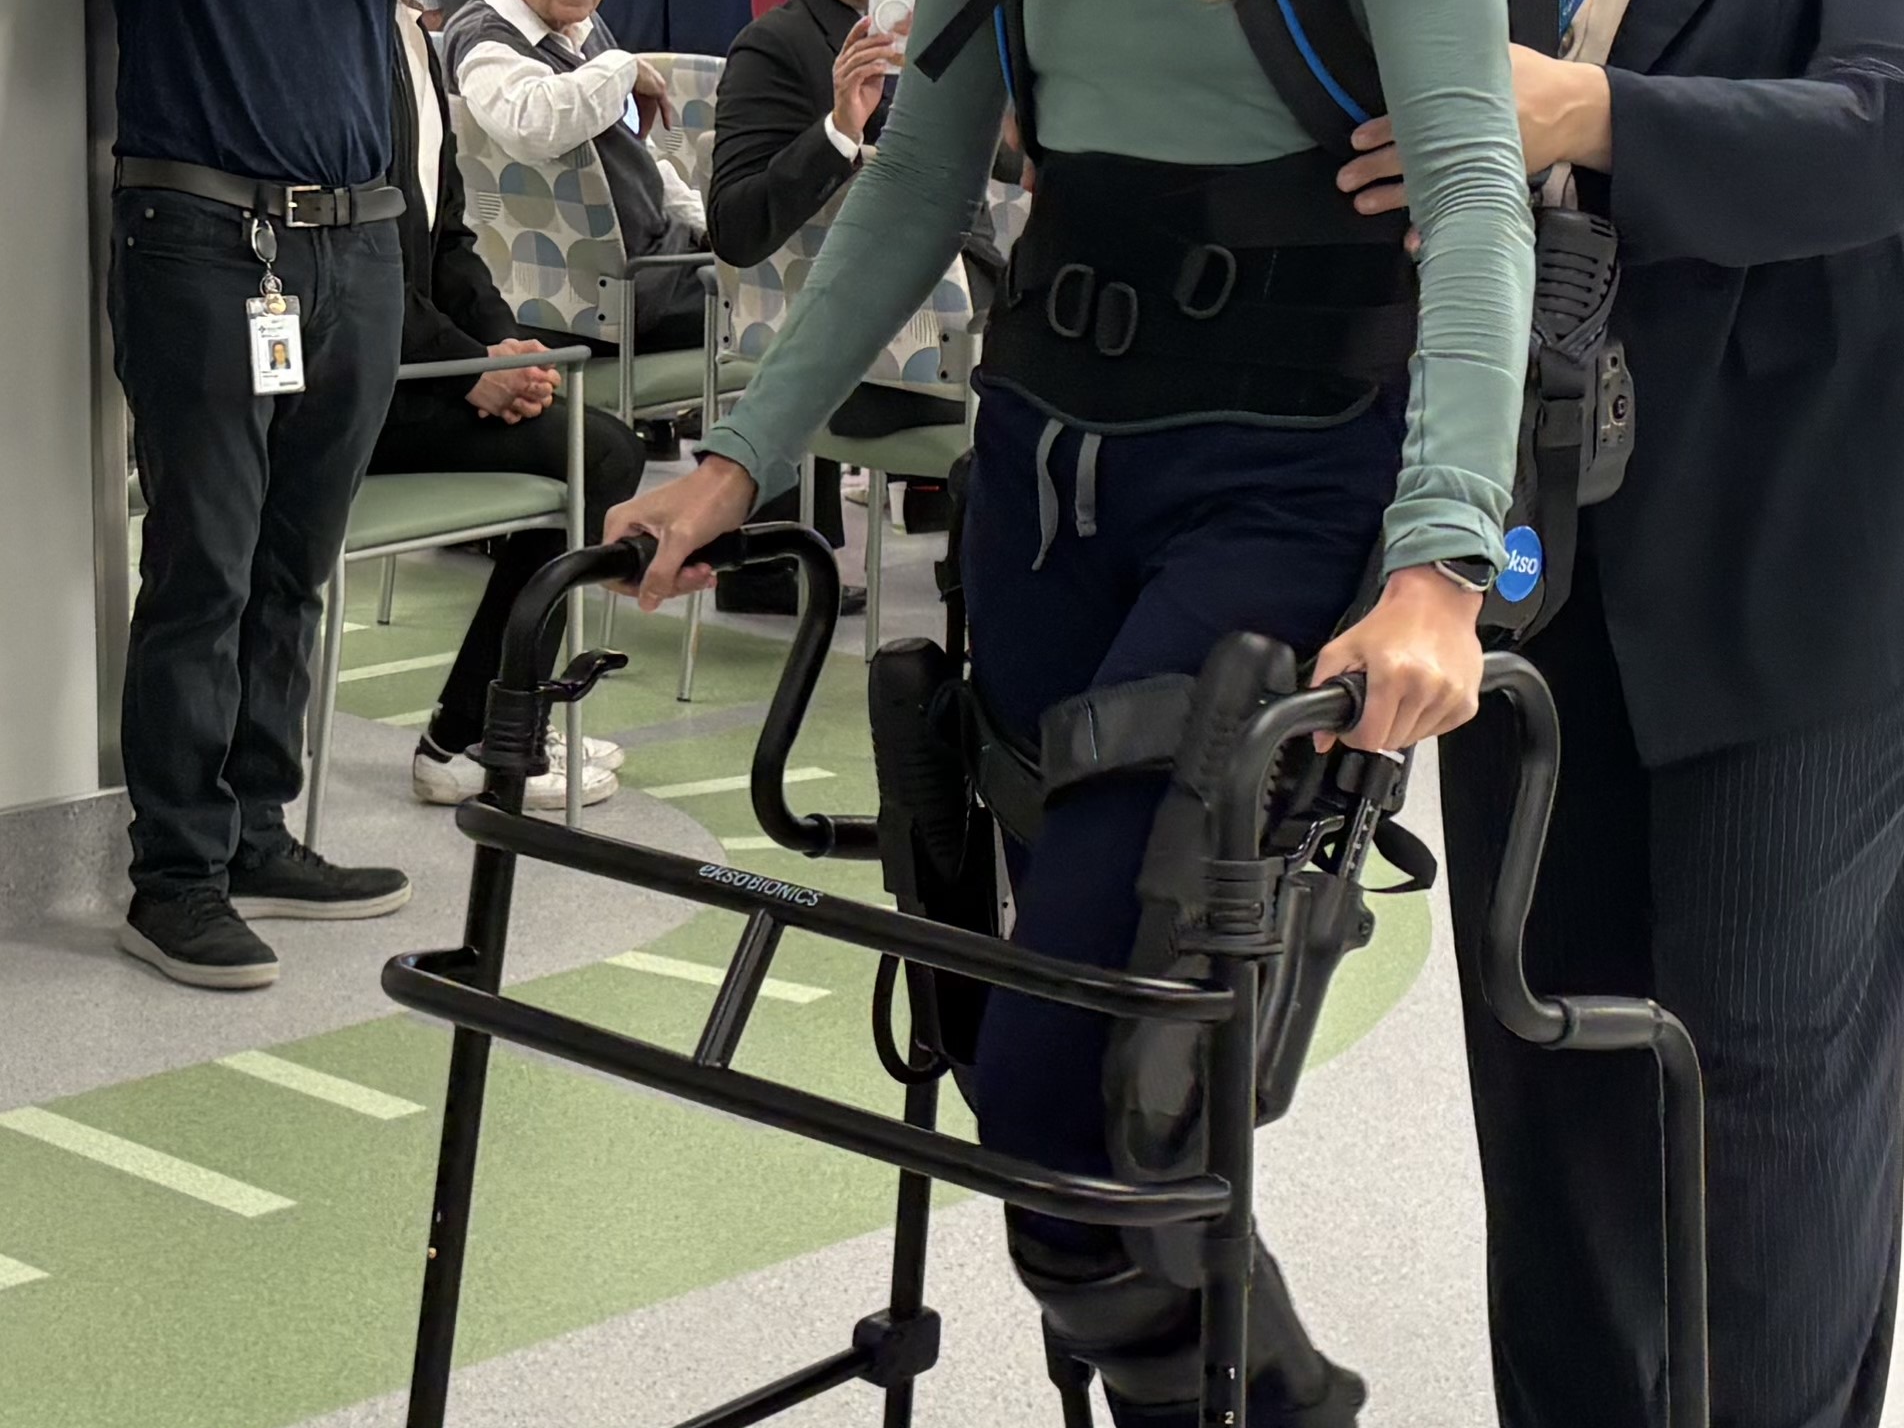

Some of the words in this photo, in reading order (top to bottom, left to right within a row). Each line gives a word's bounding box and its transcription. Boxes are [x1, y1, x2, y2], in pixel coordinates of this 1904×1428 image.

[1508, 549, 1538, 575] kso
[1229, 1367, 1236, 1380] 1
[1224, 1411, 1235, 1425] 2
